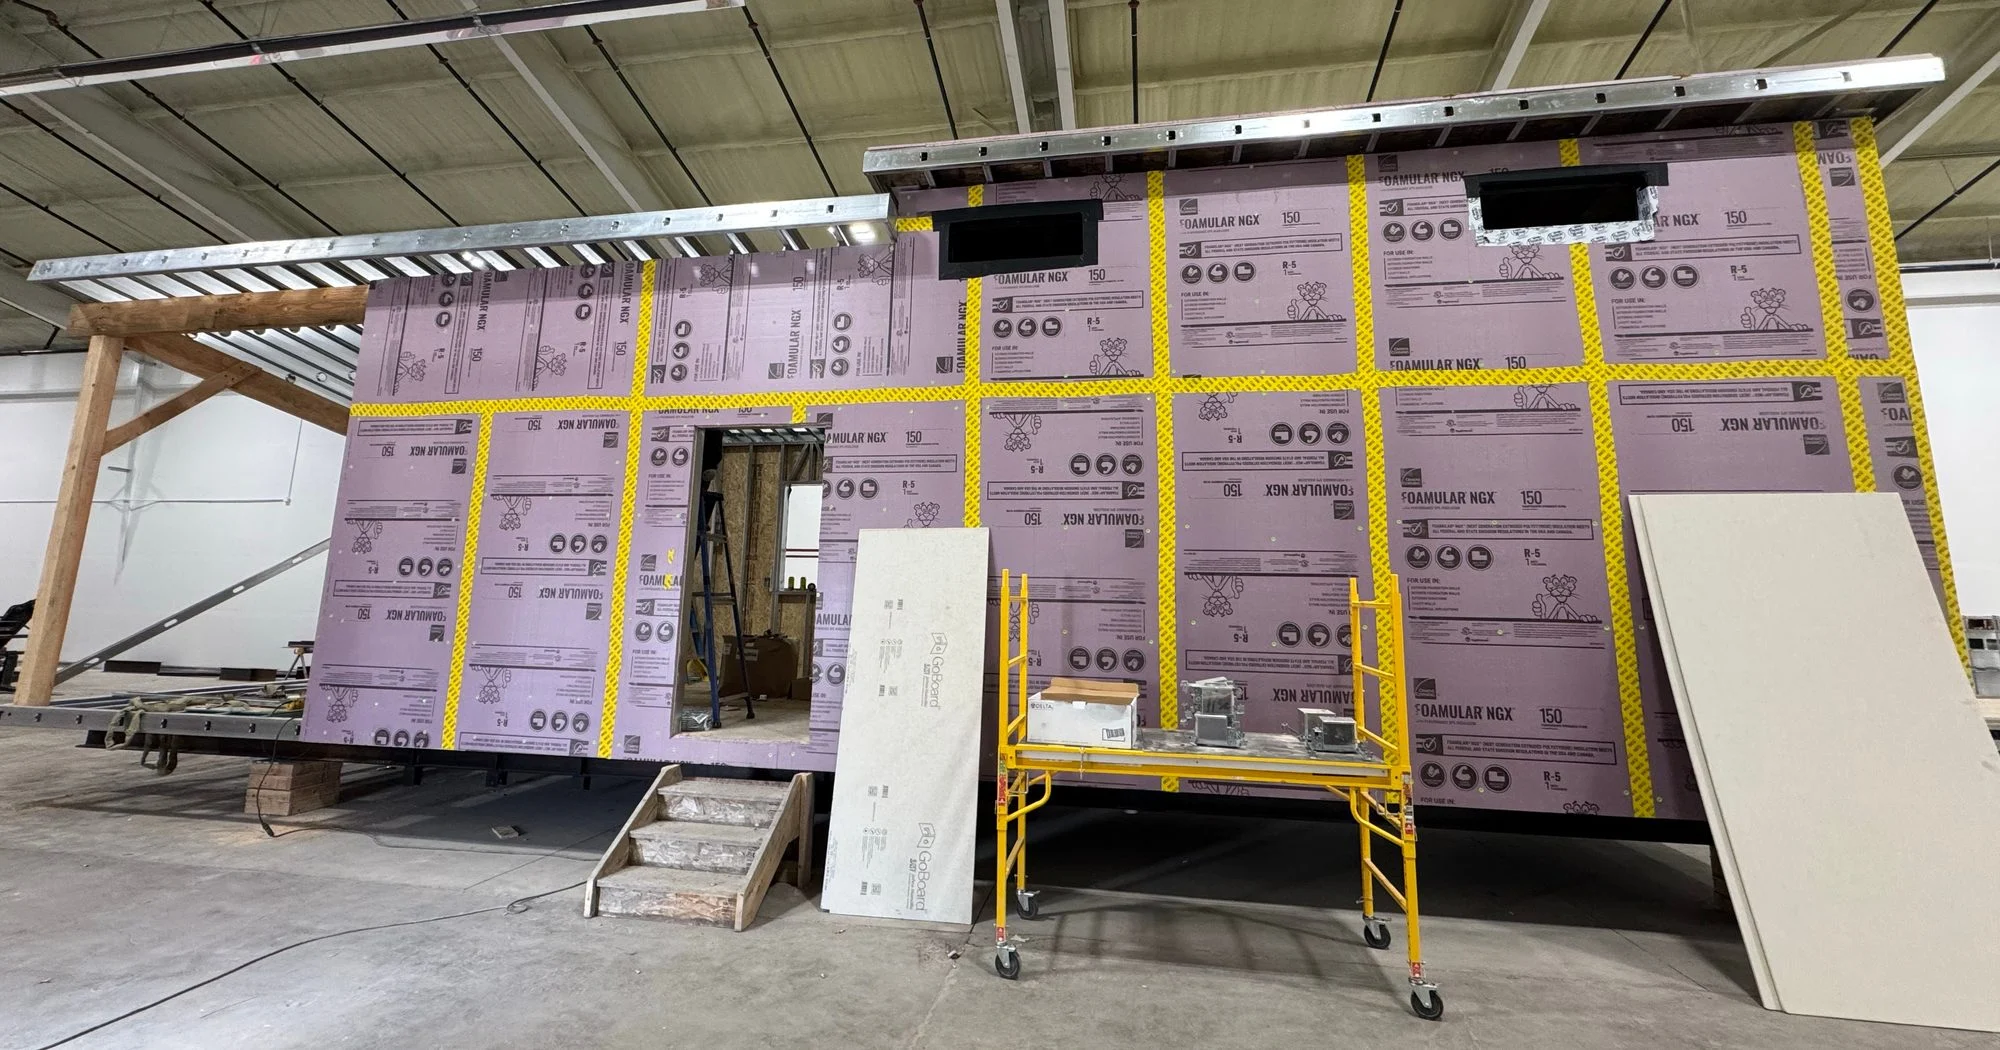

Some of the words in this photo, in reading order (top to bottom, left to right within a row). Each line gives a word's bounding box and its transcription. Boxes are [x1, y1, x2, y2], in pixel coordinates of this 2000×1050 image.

[1378, 172, 1439, 186] FOAMULAR
[1442, 171, 1464, 182] NGX
[1238, 215, 1260, 226] NGX
[1282, 212, 1300, 224] 150
[1673, 214, 1699, 226] NGX
[1724, 210, 1747, 224] 150
[1048, 271, 1068, 282] NGX
[1089, 269, 1105, 280] 150
[1730, 265, 1747, 274] R-5
[622, 262, 634, 304] OAMULAR
[793, 276, 804, 291] 150
[480, 271, 492, 311] OAMULAR
[620, 306, 630, 324] NGX
[791, 309, 801, 328] NGX
[1087, 317, 1100, 325] R-5
[477, 314, 487, 330] NGX
[472, 348, 482, 361] 150
[616, 341, 627, 356] 150
[787, 330, 800, 379] FOAMULAR
[1390, 359, 1452, 371] FOAMULAR
[1456, 358, 1480, 370] NGX
[1505, 356, 1526, 369] 150
[528, 419, 541, 430] 150
[558, 419, 574, 430] NGX
[577, 419, 618, 430] OAMULAR
[1672, 418, 1694, 432] 150
[1721, 417, 1748, 431] NGX
[825, 432, 864, 443] AMULAR
[867, 432, 886, 442] NGX
[906, 431, 922, 442] 150
[1228, 435, 1242, 443] R-5
[382, 446, 394, 456] 150
[410, 446, 425, 456] NGX
[427, 446, 466, 456] OAMULAR
[1031, 466, 1044, 474] R-5
[1223, 484, 1242, 496] 150
[1266, 484, 1288, 496] NGX
[1402, 491, 1466, 504] FOAMULAR
[1470, 492, 1495, 504] NGX
[1520, 491, 1542, 505] 150
[1024, 513, 1042, 525] 150
[1064, 514, 1084, 525] NGX
[1089, 513, 1144, 525] FOAMULAR
[1524, 549, 1540, 558] R-5
[508, 587, 522, 598] 150
[539, 588, 556, 598] NGX
[358, 608, 370, 619] 150
[386, 610, 404, 620] NGX
[816, 614, 851, 626] AMULA
[1234, 634, 1248, 642] R-5
[1028, 658, 1042, 666] R-5
[930, 656, 944, 707] GoBoard
[1238, 688, 1248, 700] 15
[1273, 688, 1297, 702] NGX
[1301, 689, 1354, 704] AMULAR
[1415, 703, 1482, 719] FOAMULAR
[1487, 707, 1513, 721] NGX
[1539, 708, 1562, 724] 150
[1544, 772, 1561, 782] R-5
[916, 851, 932, 910] GoBoard
